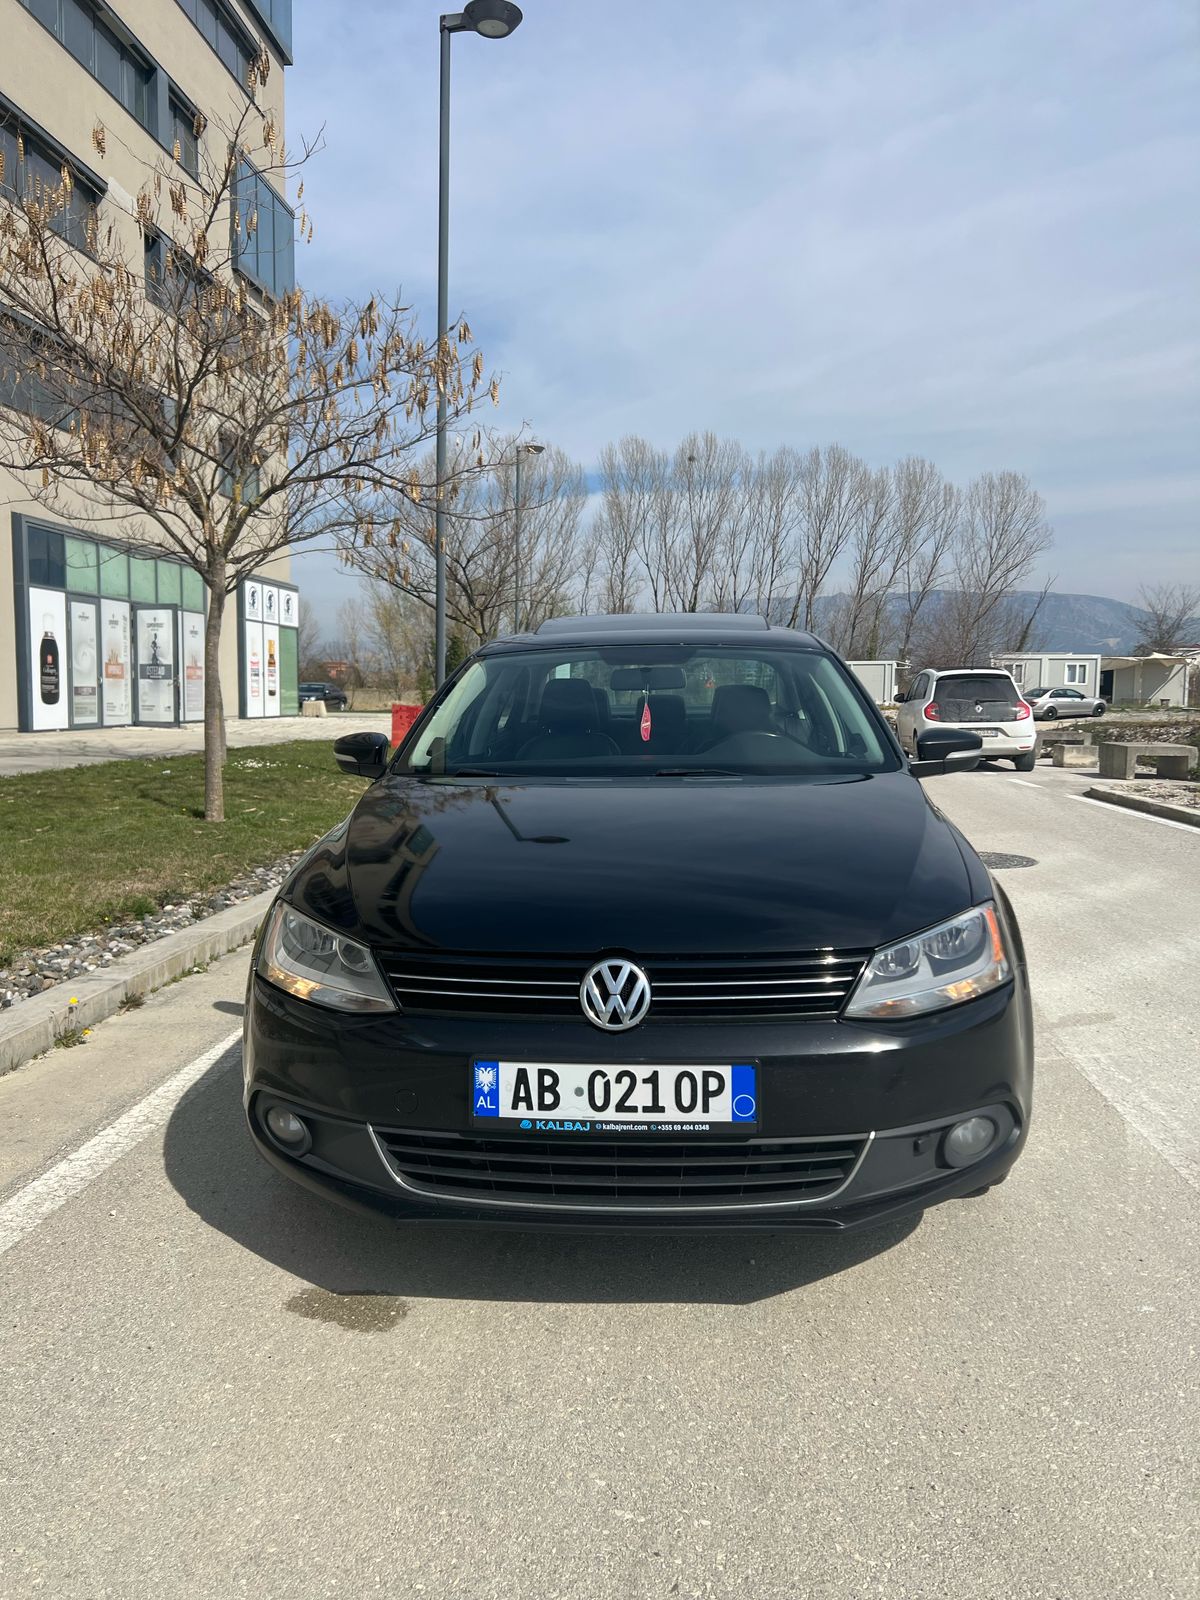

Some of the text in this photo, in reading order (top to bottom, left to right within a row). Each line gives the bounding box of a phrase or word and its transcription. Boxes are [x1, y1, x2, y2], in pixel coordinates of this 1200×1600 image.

[511, 1068, 560, 1111] AB
[476, 1096, 496, 1109] AL
[536, 1120, 591, 1131] KALBAJ
[602, 1123, 648, 1132] kalbajrent.com
